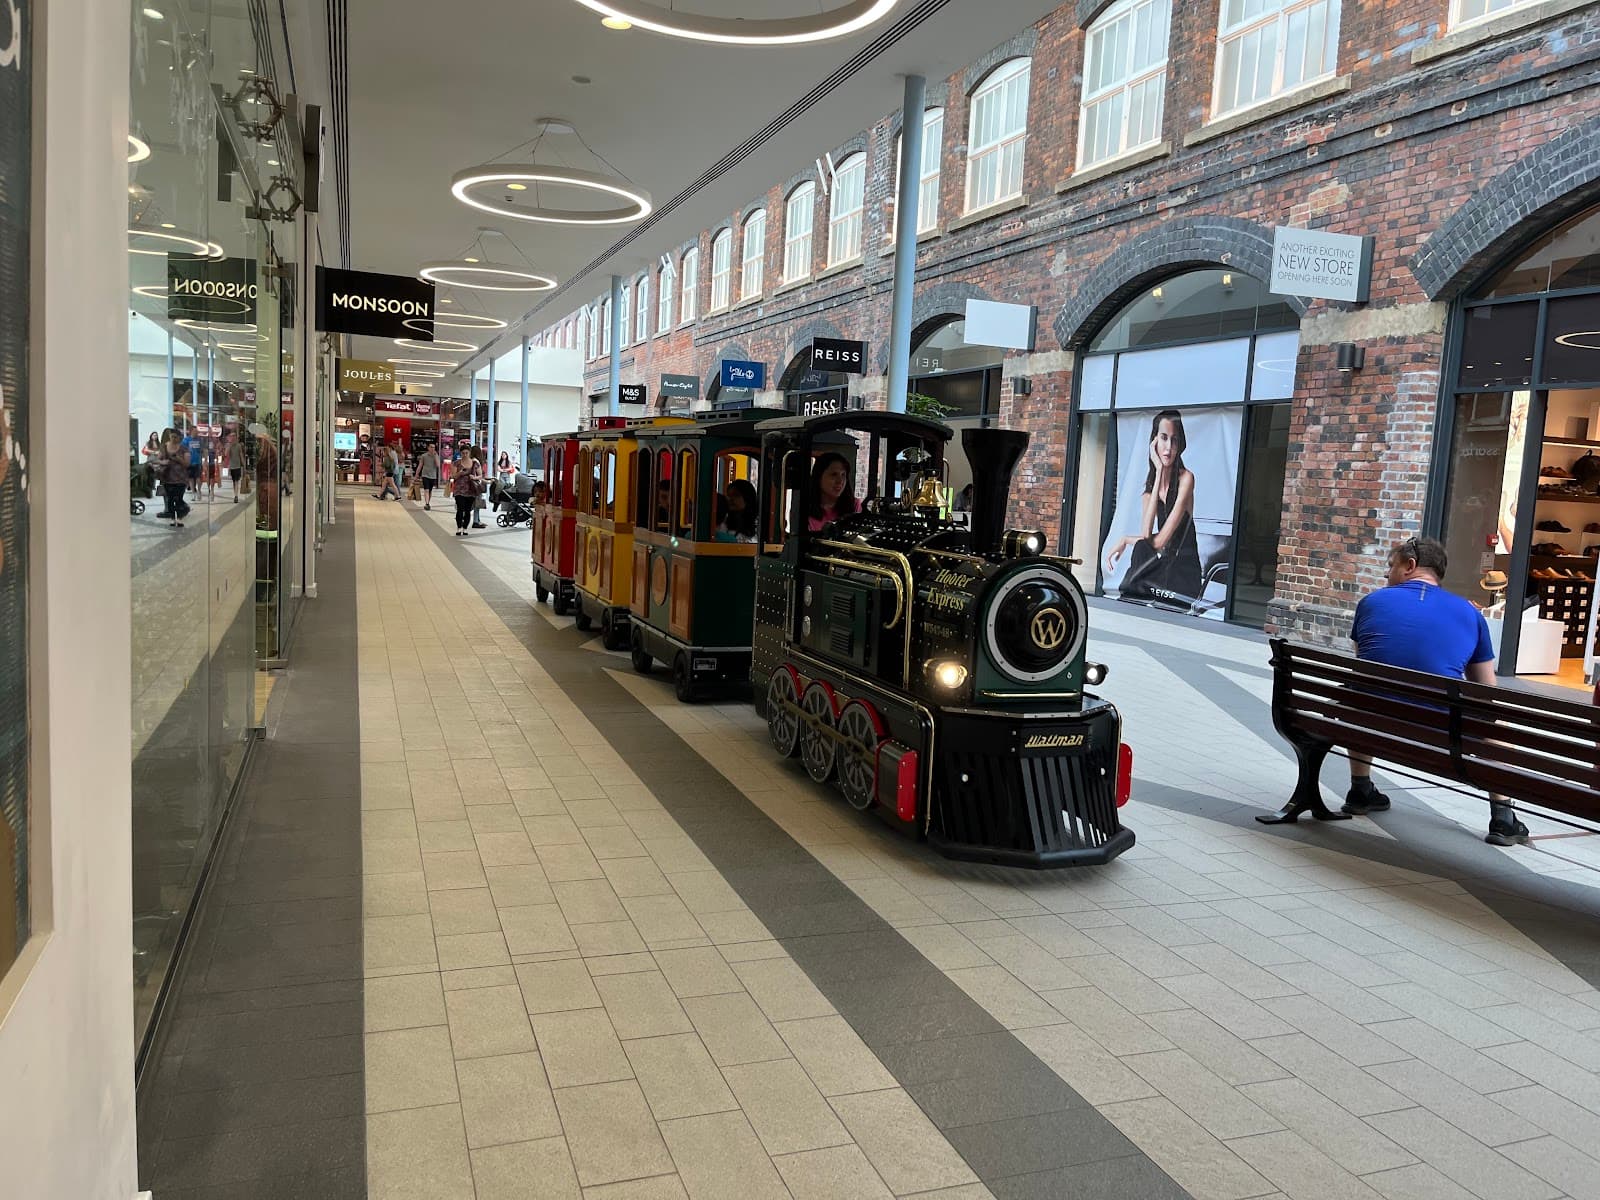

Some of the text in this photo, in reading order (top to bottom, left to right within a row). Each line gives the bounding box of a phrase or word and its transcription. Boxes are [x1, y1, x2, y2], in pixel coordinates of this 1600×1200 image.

[1281, 243, 1355, 259] ANOTHER EXCITING
[1278, 254, 1354, 276] NEW STORE
[1278, 271, 1353, 287] OPENING HERE SOON
[332, 292, 428, 317] MONSOON
[815, 348, 860, 362] REISS
[343, 369, 392, 381] JOULES
[622, 388, 640, 397] M&S
[803, 399, 836, 417] REISS
[934, 568, 973, 588] Hooter
[926, 587, 966, 611] Express
